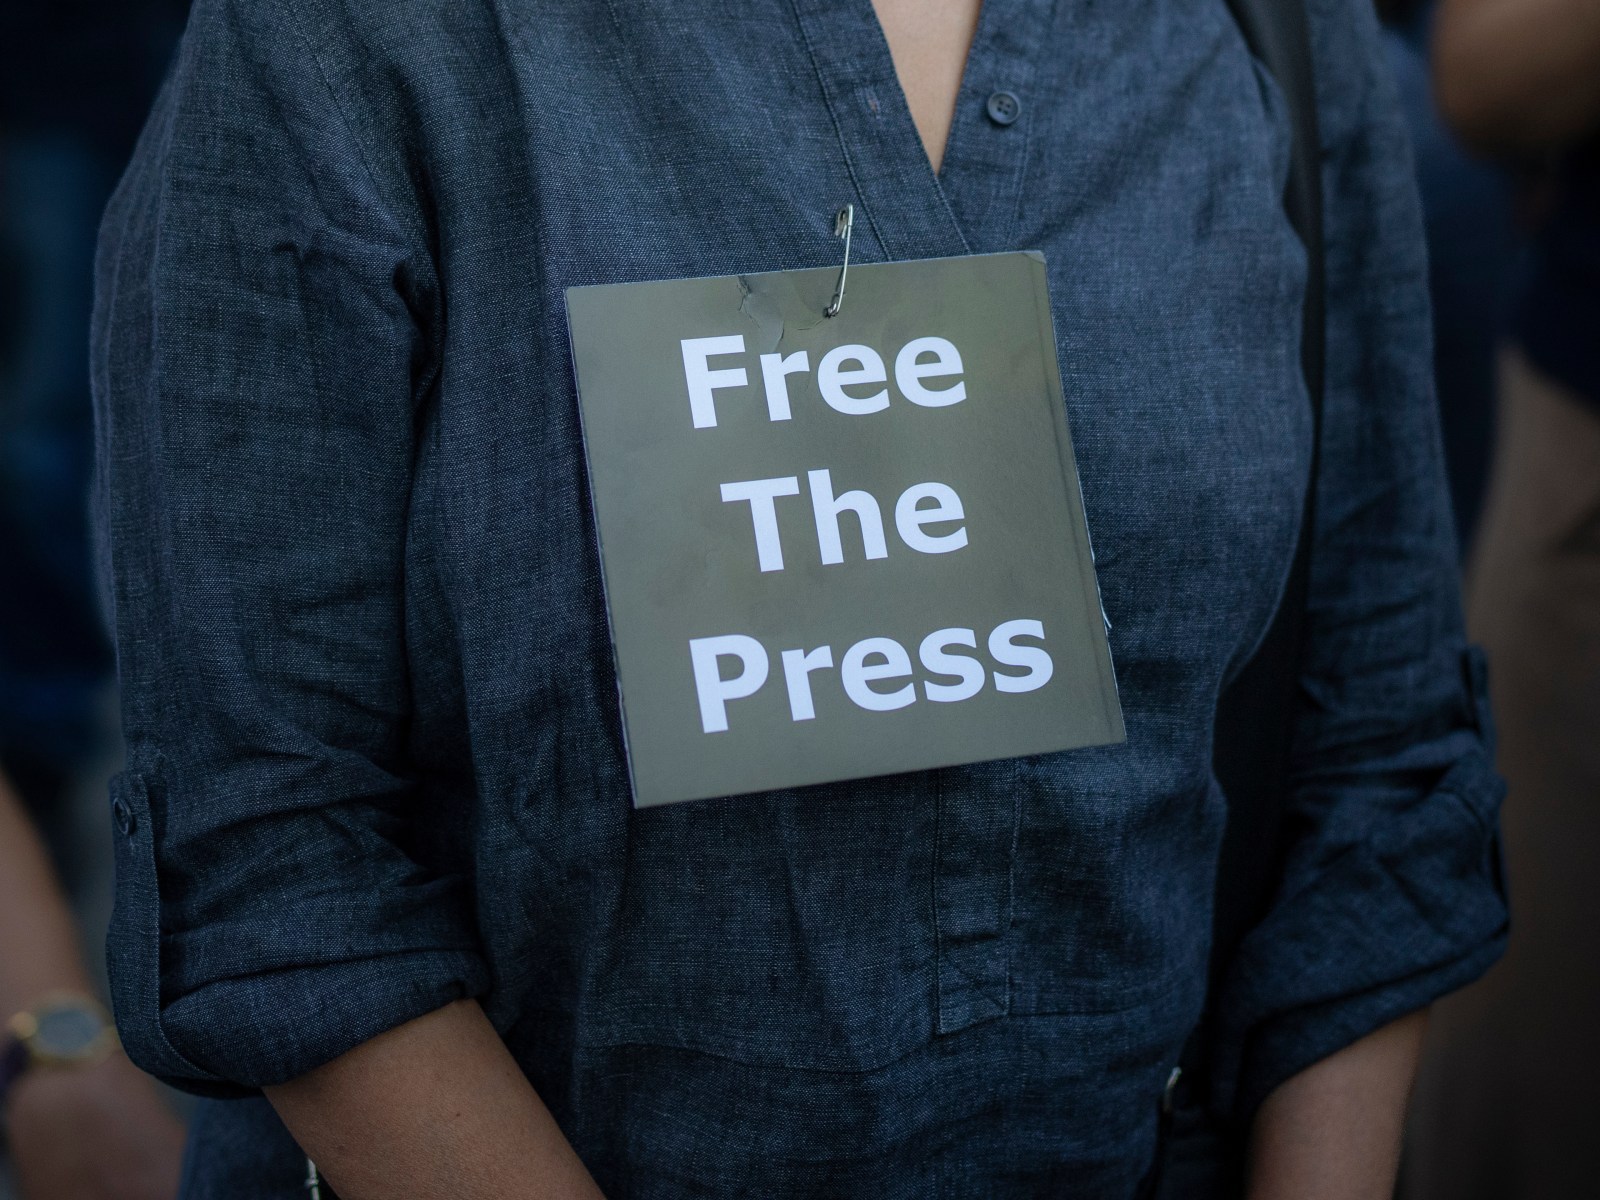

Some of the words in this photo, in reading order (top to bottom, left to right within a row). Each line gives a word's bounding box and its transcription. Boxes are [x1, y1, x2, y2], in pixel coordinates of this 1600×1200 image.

[680, 334, 967, 429] Free
[719, 468, 969, 573] The
[689, 619, 1054, 734] Press
